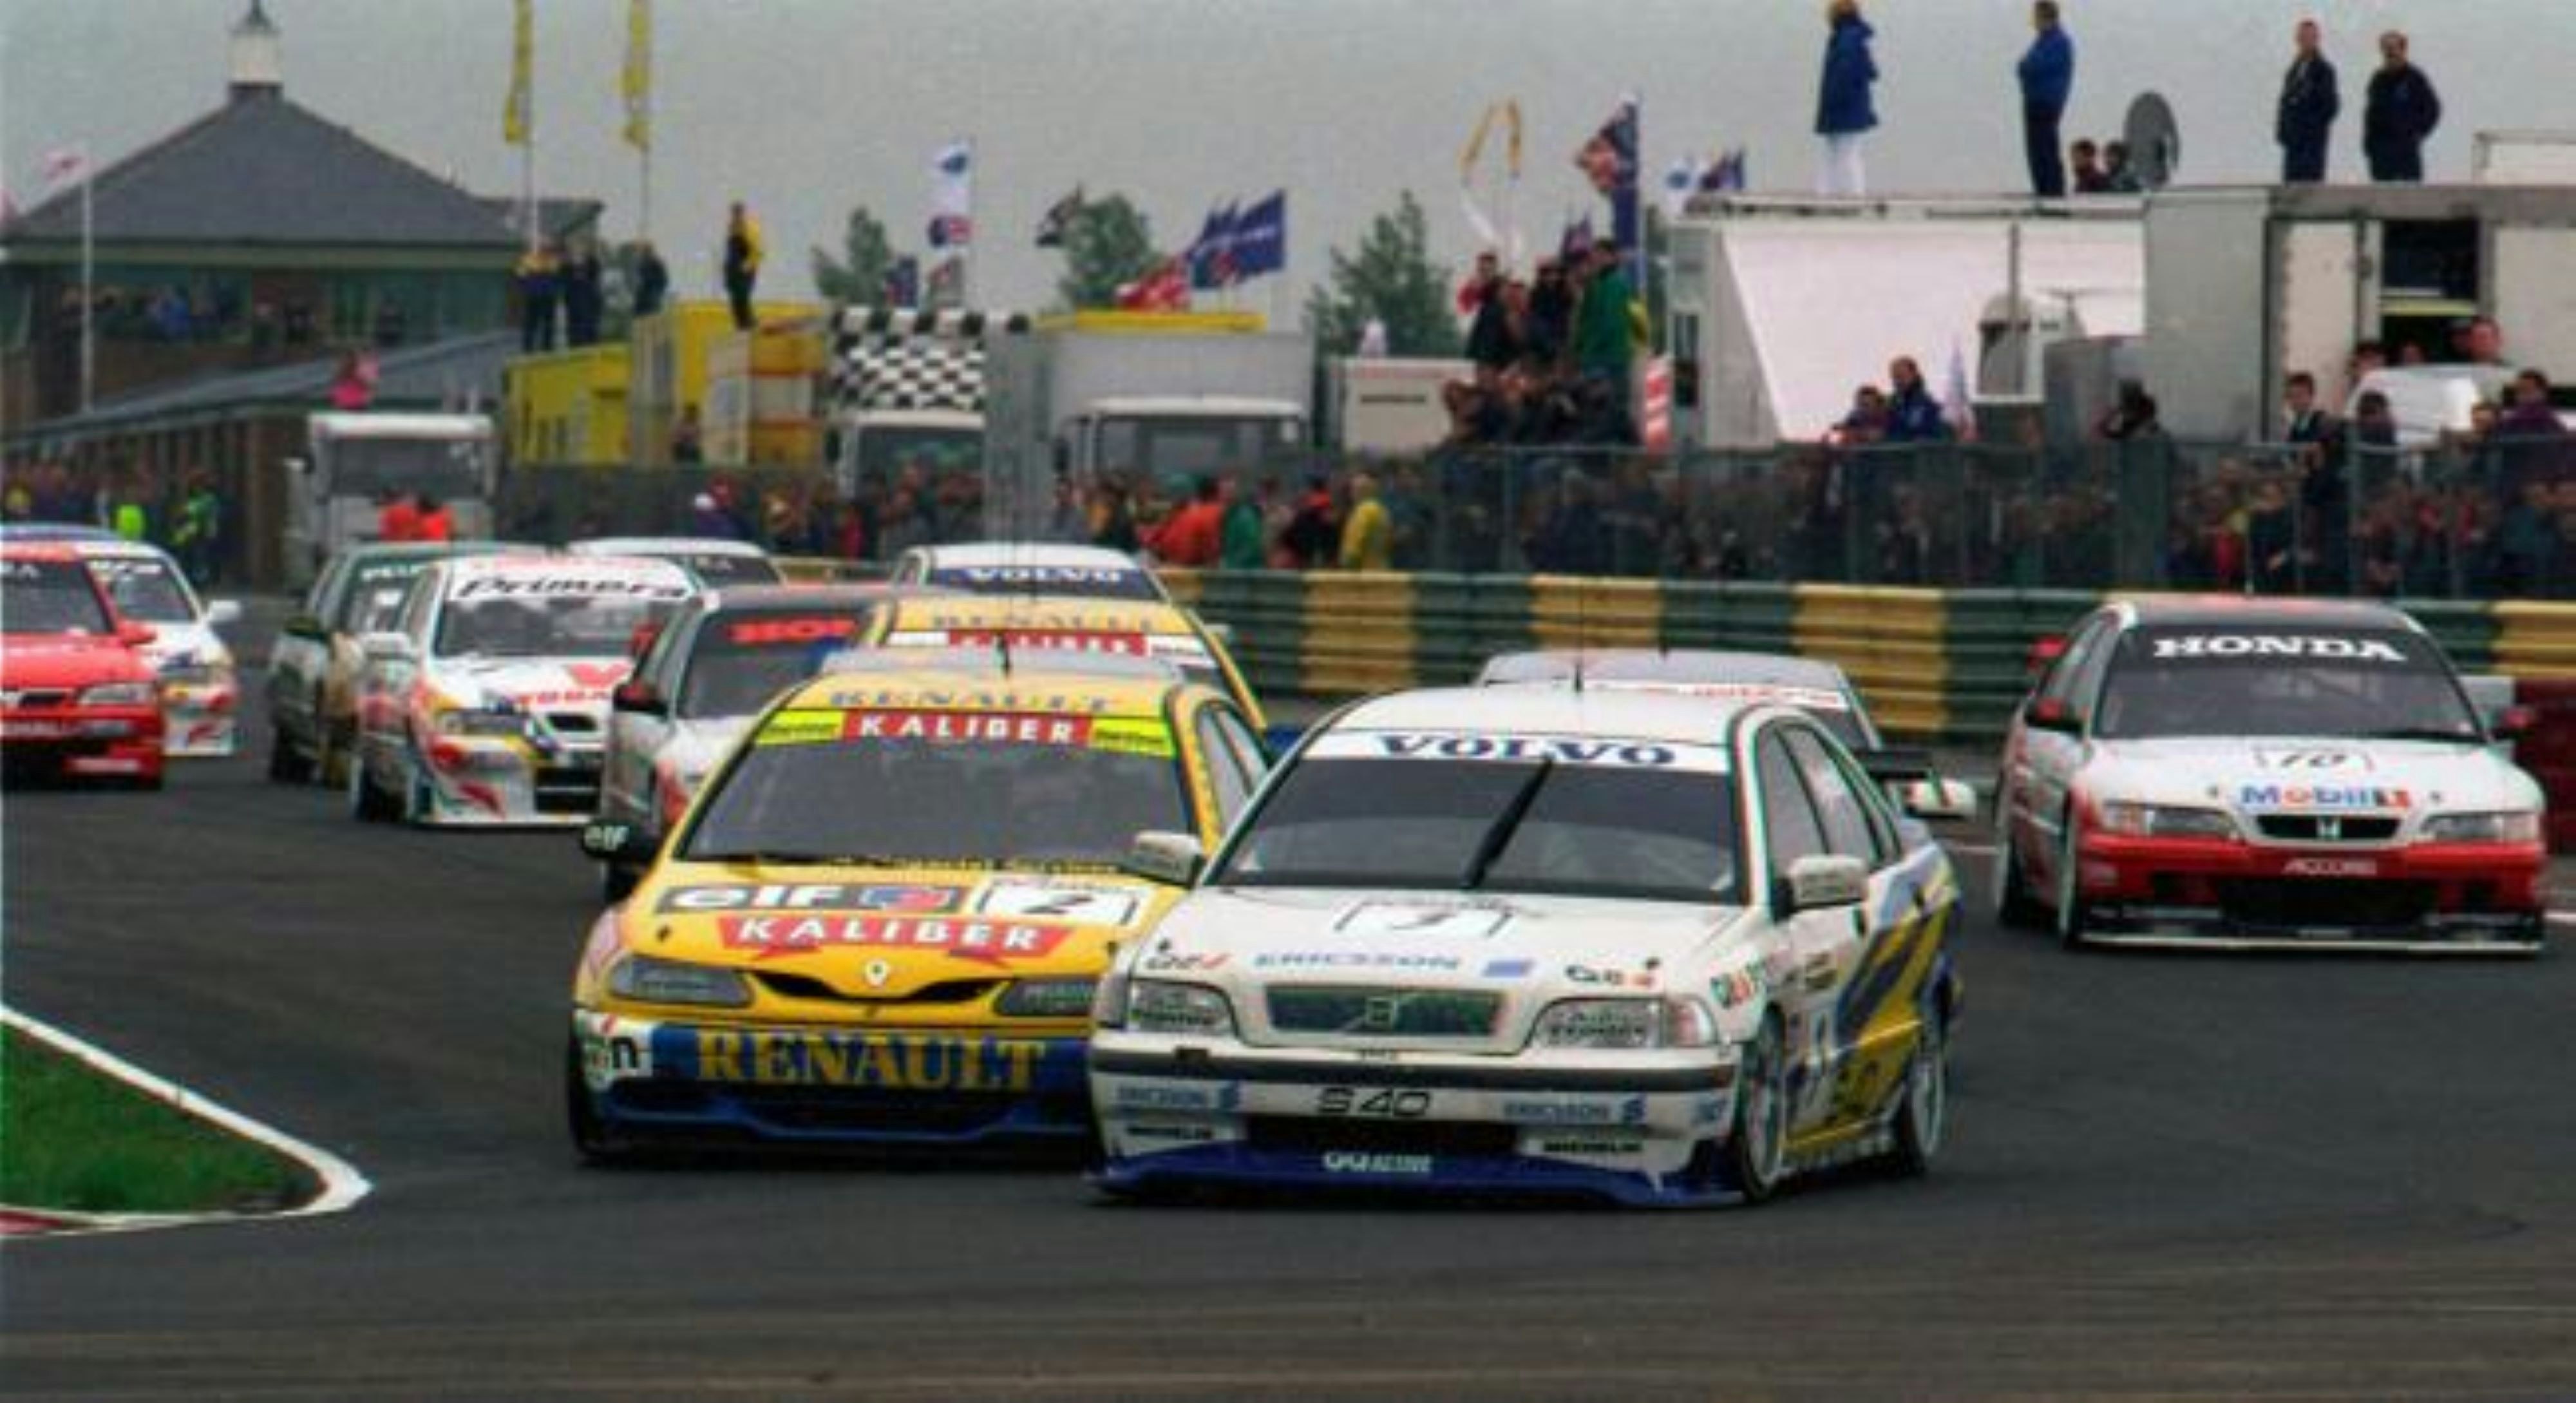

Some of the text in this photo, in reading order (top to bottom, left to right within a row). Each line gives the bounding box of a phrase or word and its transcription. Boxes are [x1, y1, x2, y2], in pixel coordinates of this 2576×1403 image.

[966, 566, 1123, 582] VOLVO
[2152, 635, 2408, 662] HONDA
[860, 714, 1074, 743] KALIBER
[1377, 734, 1676, 765] VOLVO
[2240, 783, 2372, 806] Mobil
[583, 825, 631, 851] elf
[736, 917, 1040, 952] KALIBER
[698, 1030, 1046, 1091] RENAULT
